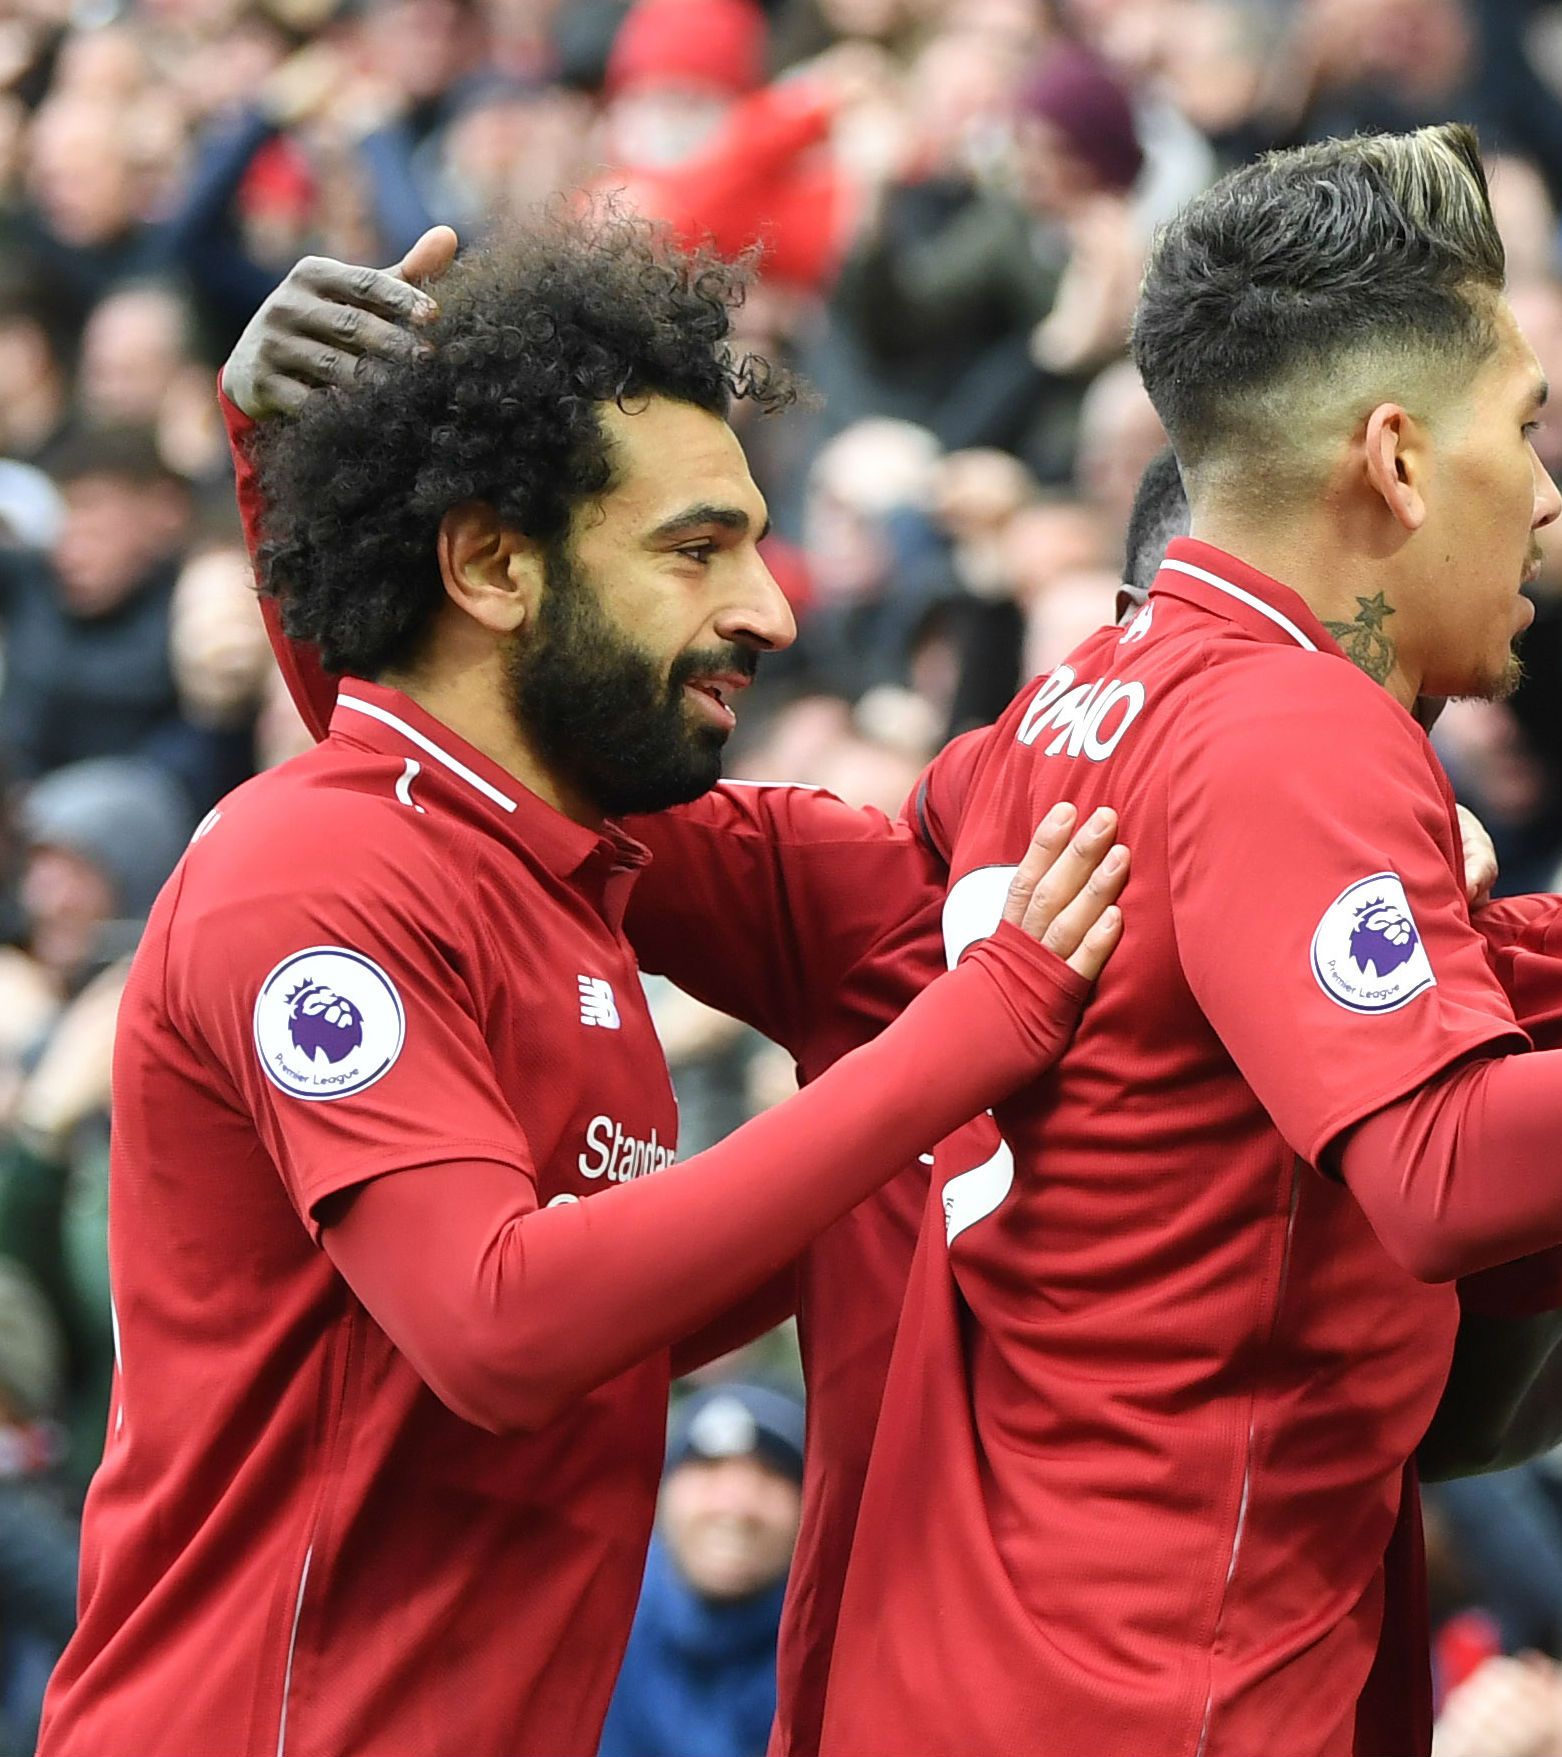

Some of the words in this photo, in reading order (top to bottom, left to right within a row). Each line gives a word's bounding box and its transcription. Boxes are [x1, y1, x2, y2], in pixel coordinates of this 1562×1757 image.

[1327, 959, 1357, 994] Premier
[1359, 984, 1400, 1000] League
[275, 1052, 309, 1083] Premier
[313, 1068, 359, 1085] League
